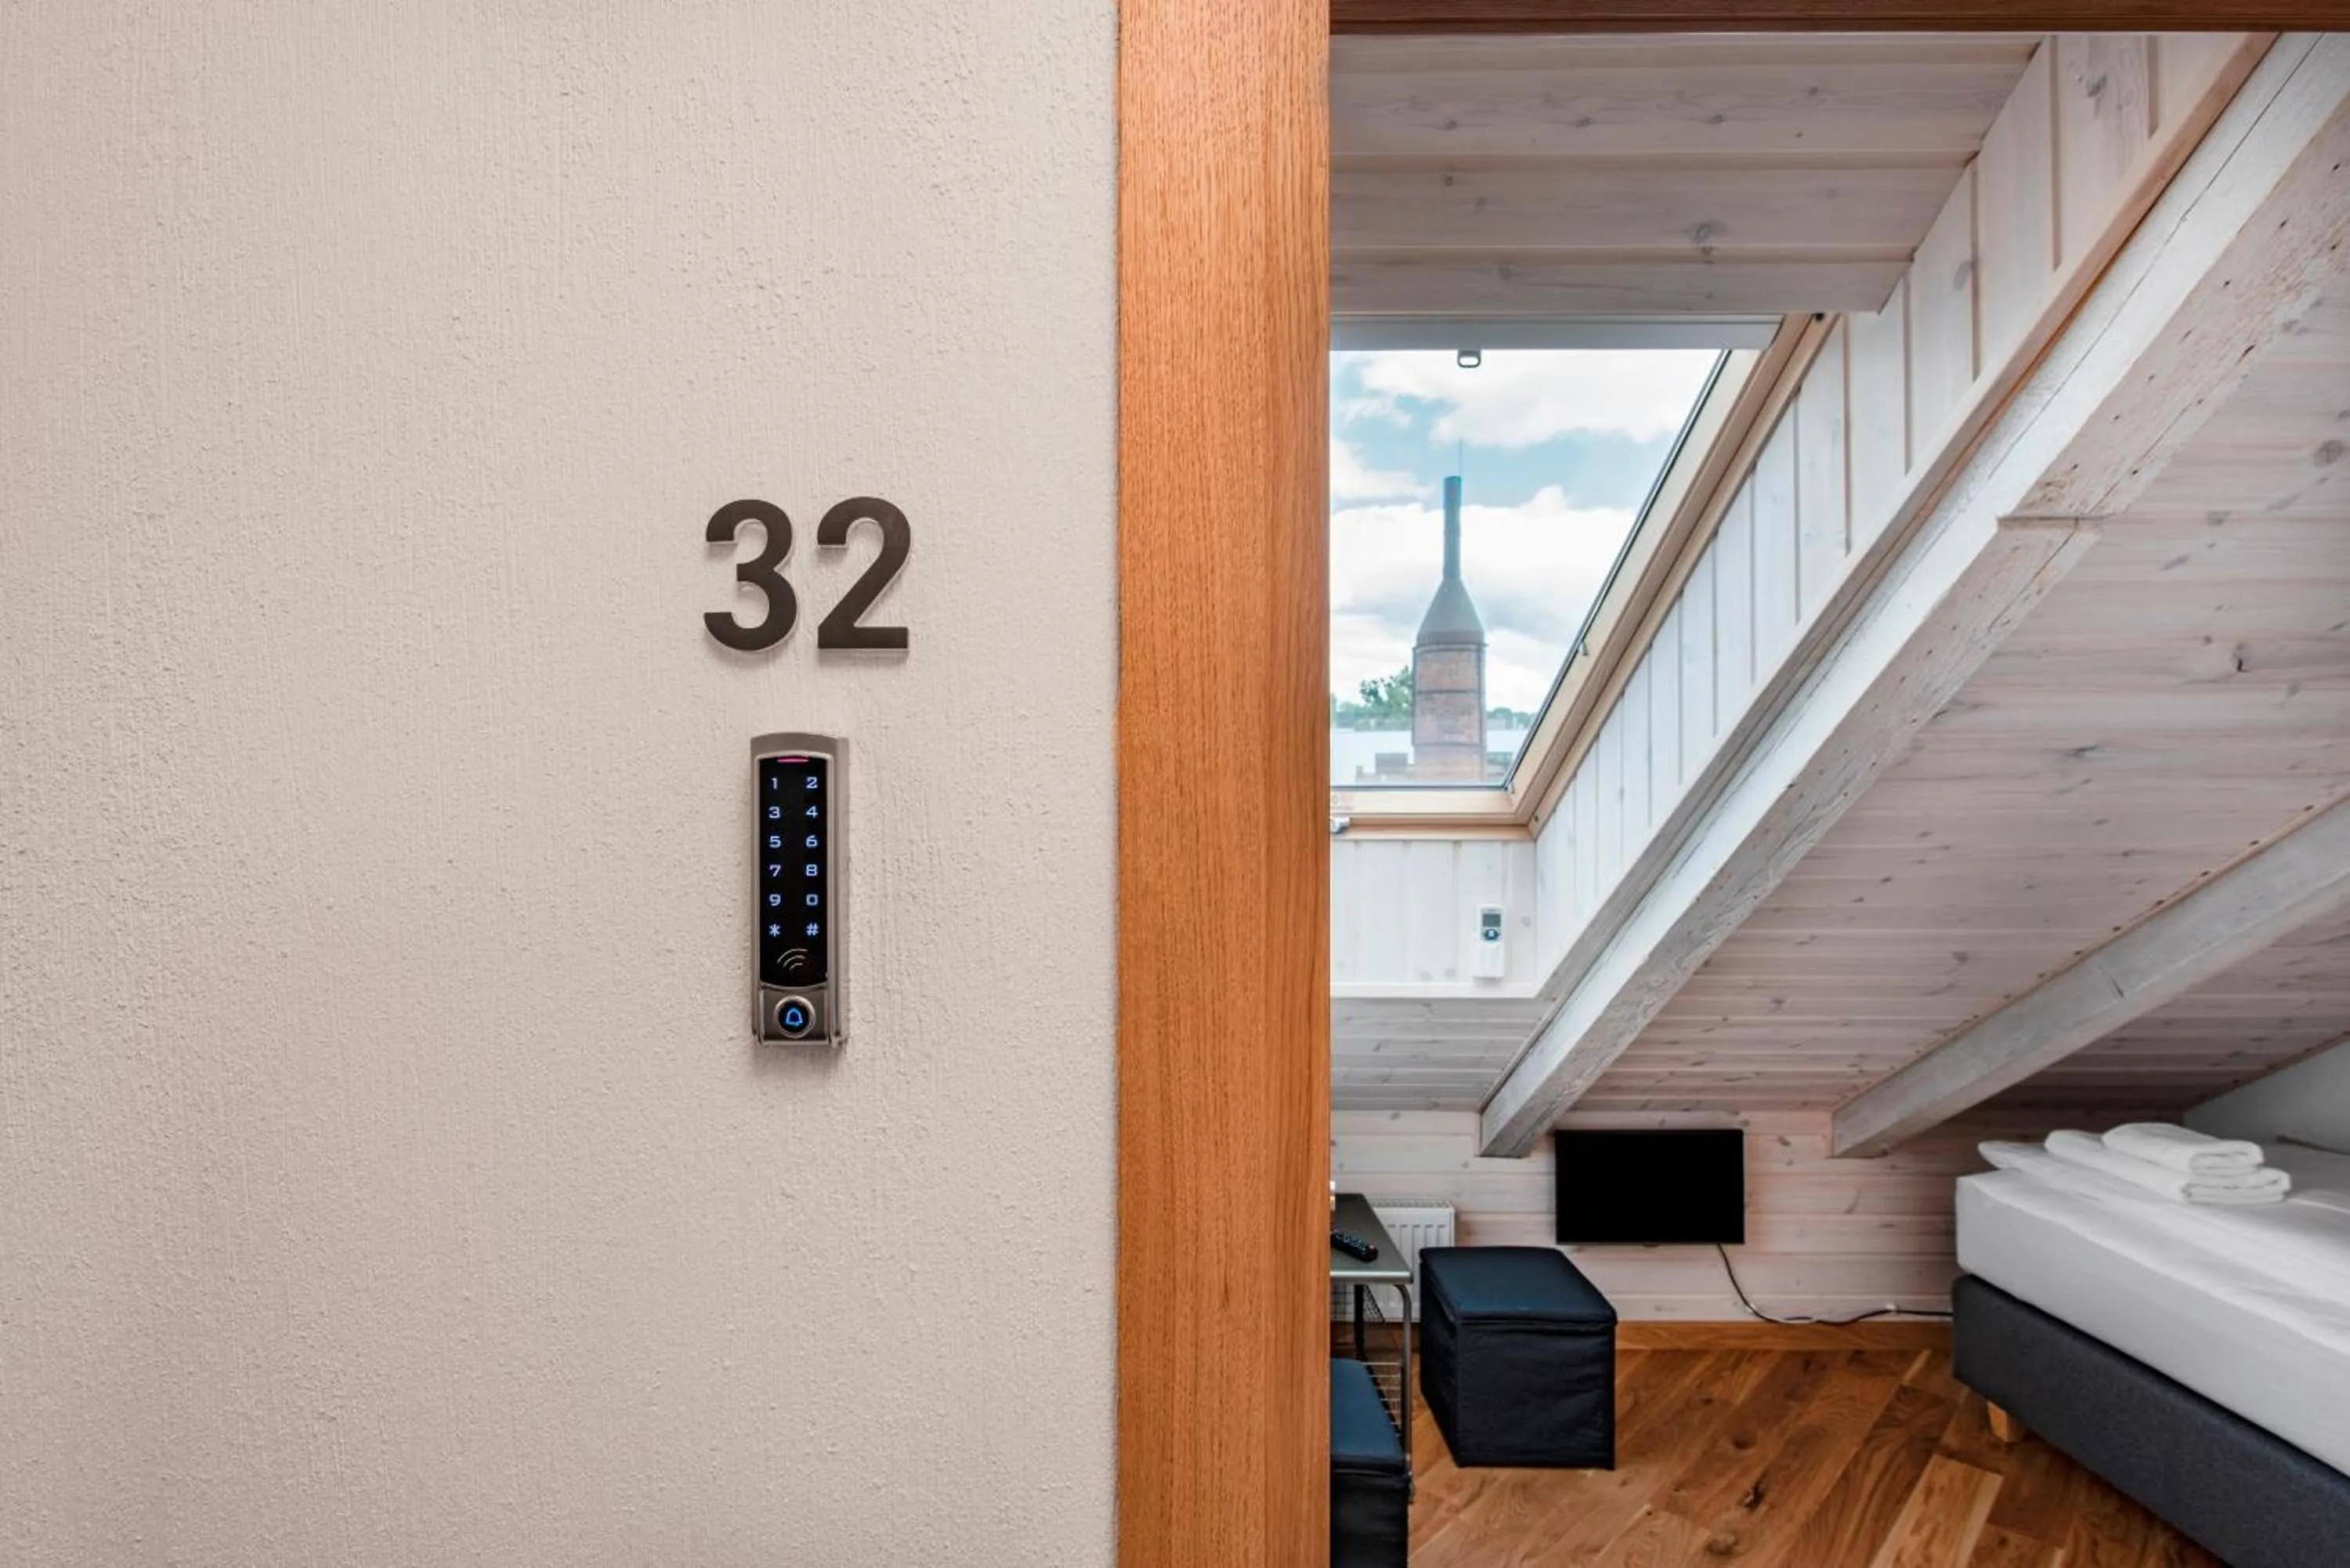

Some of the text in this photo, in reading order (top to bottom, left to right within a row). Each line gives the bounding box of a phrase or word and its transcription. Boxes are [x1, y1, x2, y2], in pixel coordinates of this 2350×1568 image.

[703, 496, 911, 652] 32
[771, 776, 818, 789] 1 2
[768, 805, 818, 818] 3 4
[769, 835, 818, 847] 5 6
[769, 864, 818, 876] 7 8
[769, 894, 819, 906] 9 0
